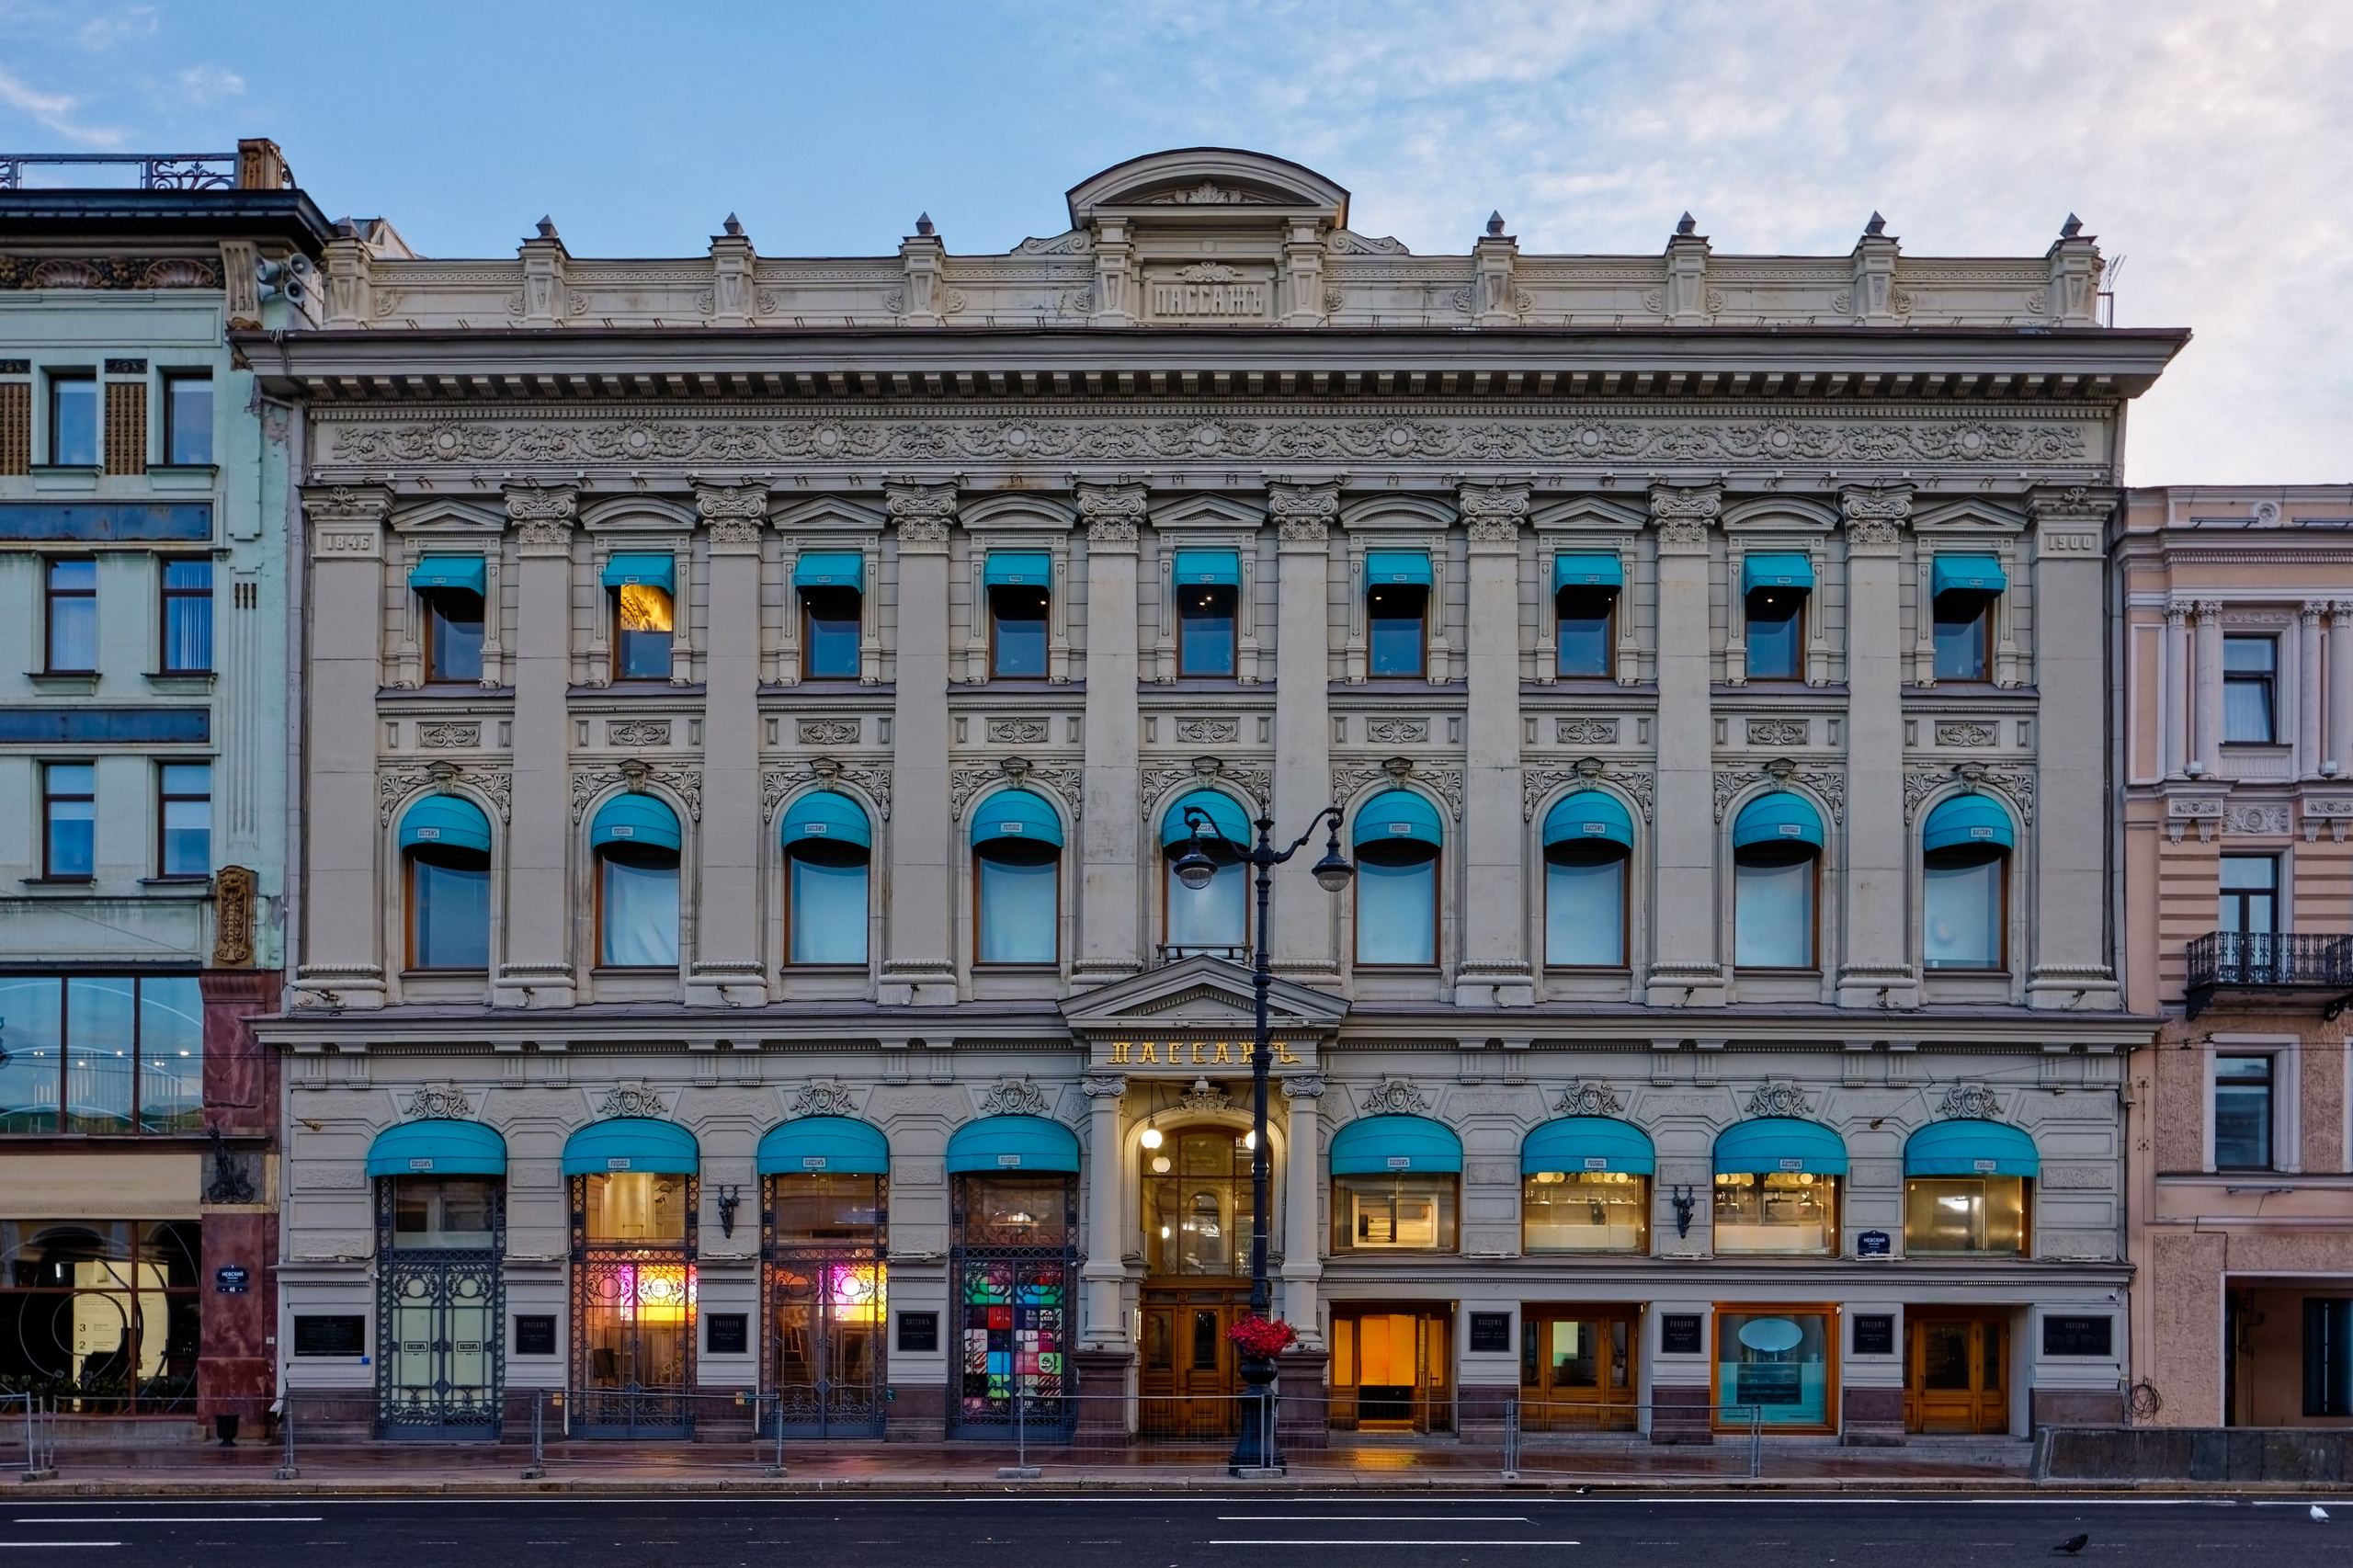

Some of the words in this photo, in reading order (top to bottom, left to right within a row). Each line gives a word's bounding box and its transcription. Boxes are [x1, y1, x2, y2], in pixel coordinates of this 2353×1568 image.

[1154, 284, 1264, 316] ПАССАЖЪ
[326, 535, 369, 551] 1846
[2049, 535, 2092, 551] 1900
[79, 1324, 86, 1332] 3
[79, 1341, 85, 1349] 2
